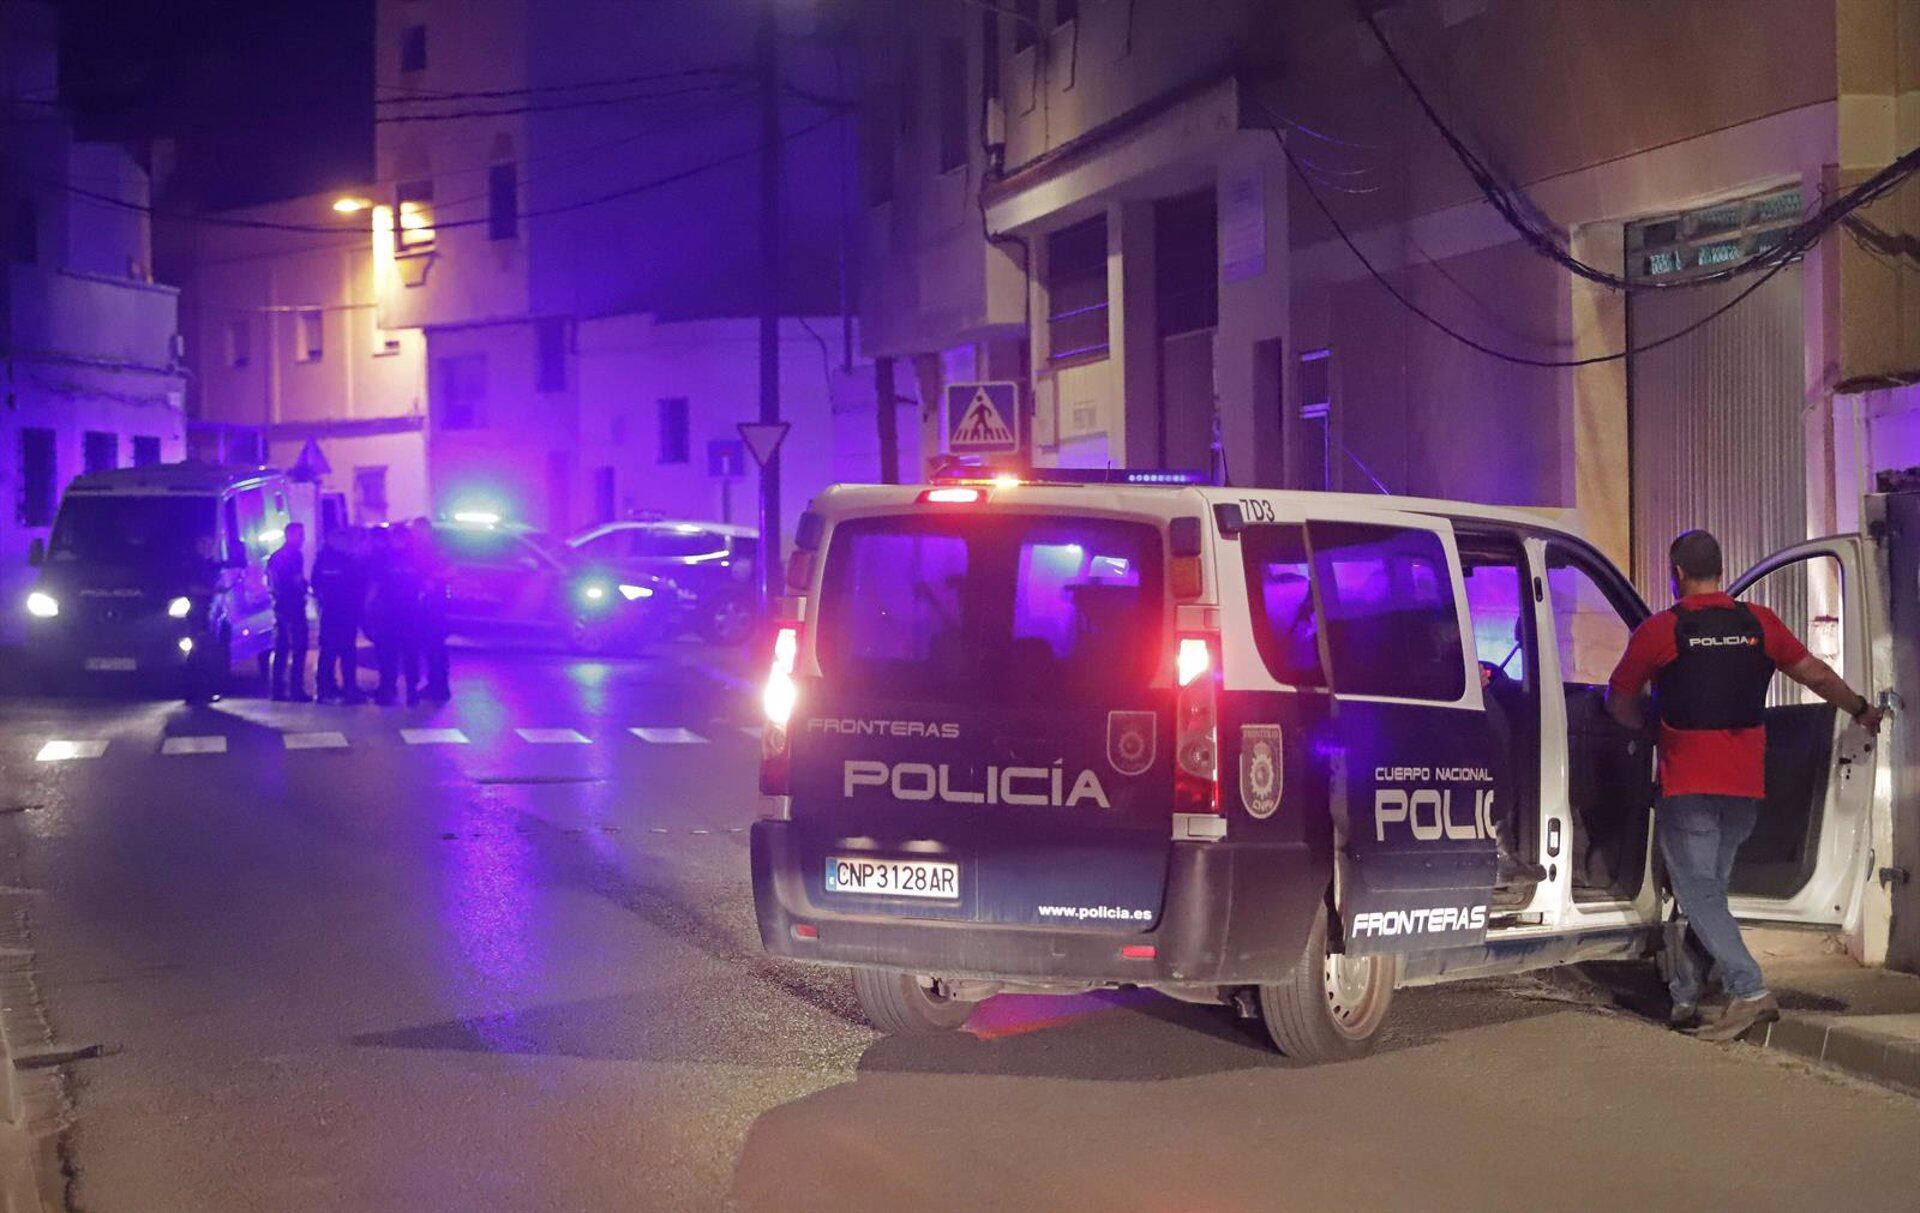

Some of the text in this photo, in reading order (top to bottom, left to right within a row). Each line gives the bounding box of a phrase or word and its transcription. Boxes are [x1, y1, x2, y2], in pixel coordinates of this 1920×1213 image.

[1239, 498, 1275, 522] 7D3
[1689, 635, 1749, 647] POLICIA
[807, 718, 960, 738] FRONTERAS
[844, 757, 1111, 808] POLICÍA
[1375, 767, 1493, 781] CUERPO NACIONAL
[837, 862, 955, 892] CNP3128AR
[1039, 905, 1152, 920] www.policia.es
[1351, 905, 1487, 938] FRONTERAS
